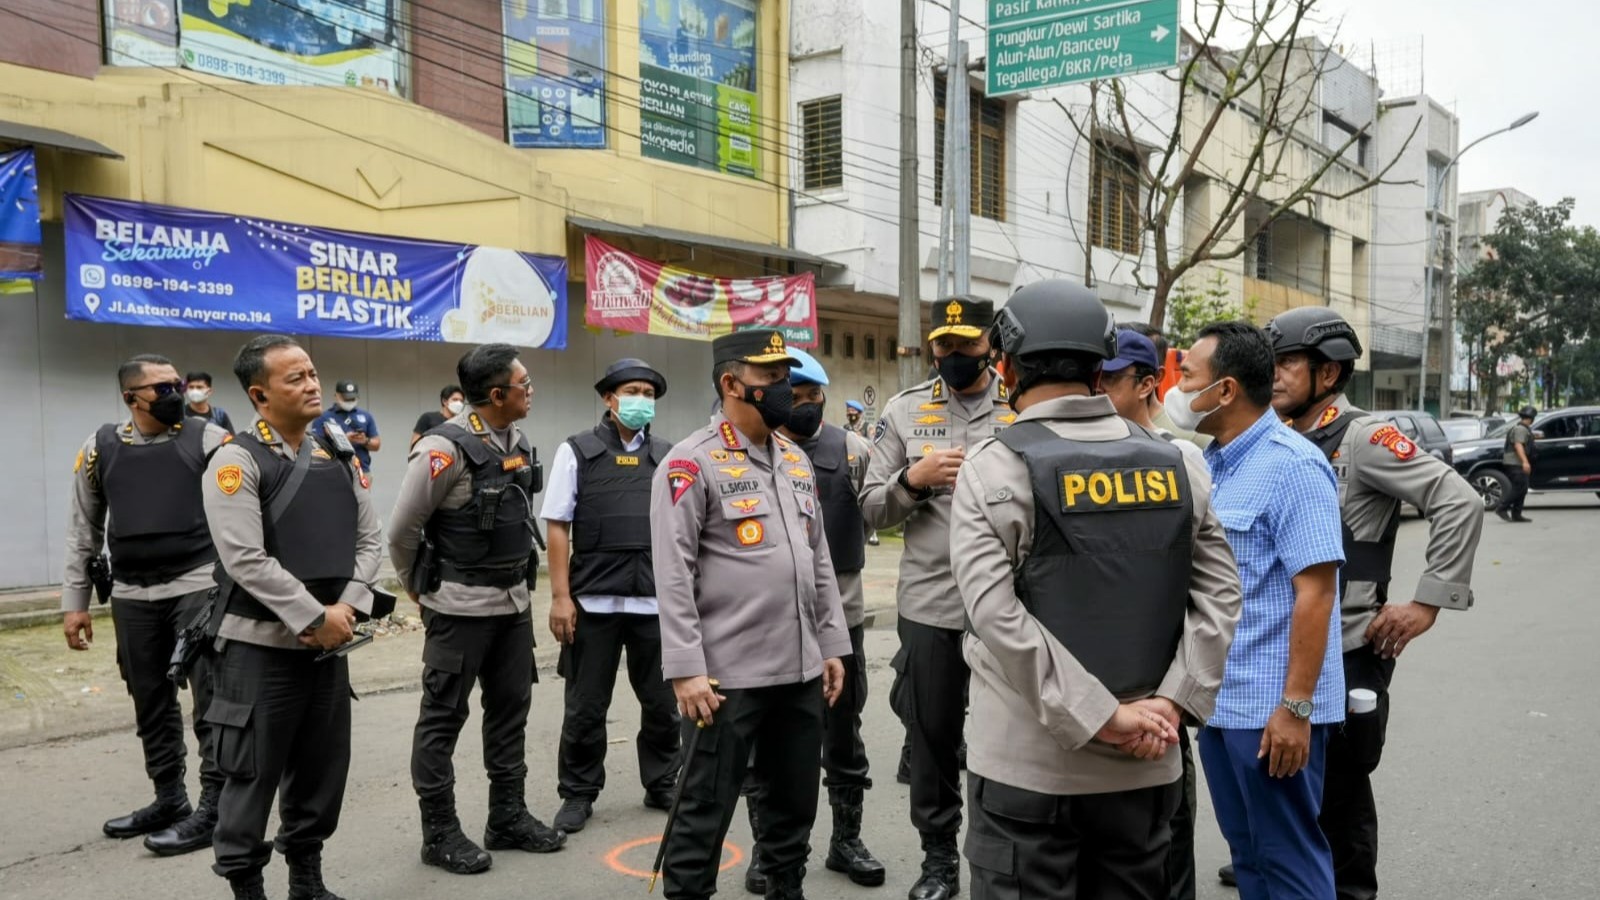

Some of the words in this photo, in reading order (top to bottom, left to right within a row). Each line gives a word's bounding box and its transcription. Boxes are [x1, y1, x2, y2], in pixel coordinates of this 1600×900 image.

[995, 0, 1031, 18] Pasir
[1093, 9, 1141, 31] Sartika
[197, 53, 286, 85] 0898-194-3399
[641, 131, 696, 156] okopedia
[96, 218, 231, 254] BELANJA
[101, 238, 218, 267] Sekarang
[309, 241, 398, 276] SINAR
[111, 273, 234, 296] 0898-194-3399
[296, 265, 412, 303] BERLIAN
[182, 307, 227, 323] Anyar
[229, 311, 272, 323] no.194
[297, 293, 414, 330] PLASTIK
[496, 303, 548, 317] BERLIAN
[913, 428, 946, 437] ULIN
[1063, 470, 1179, 507] POLISI
